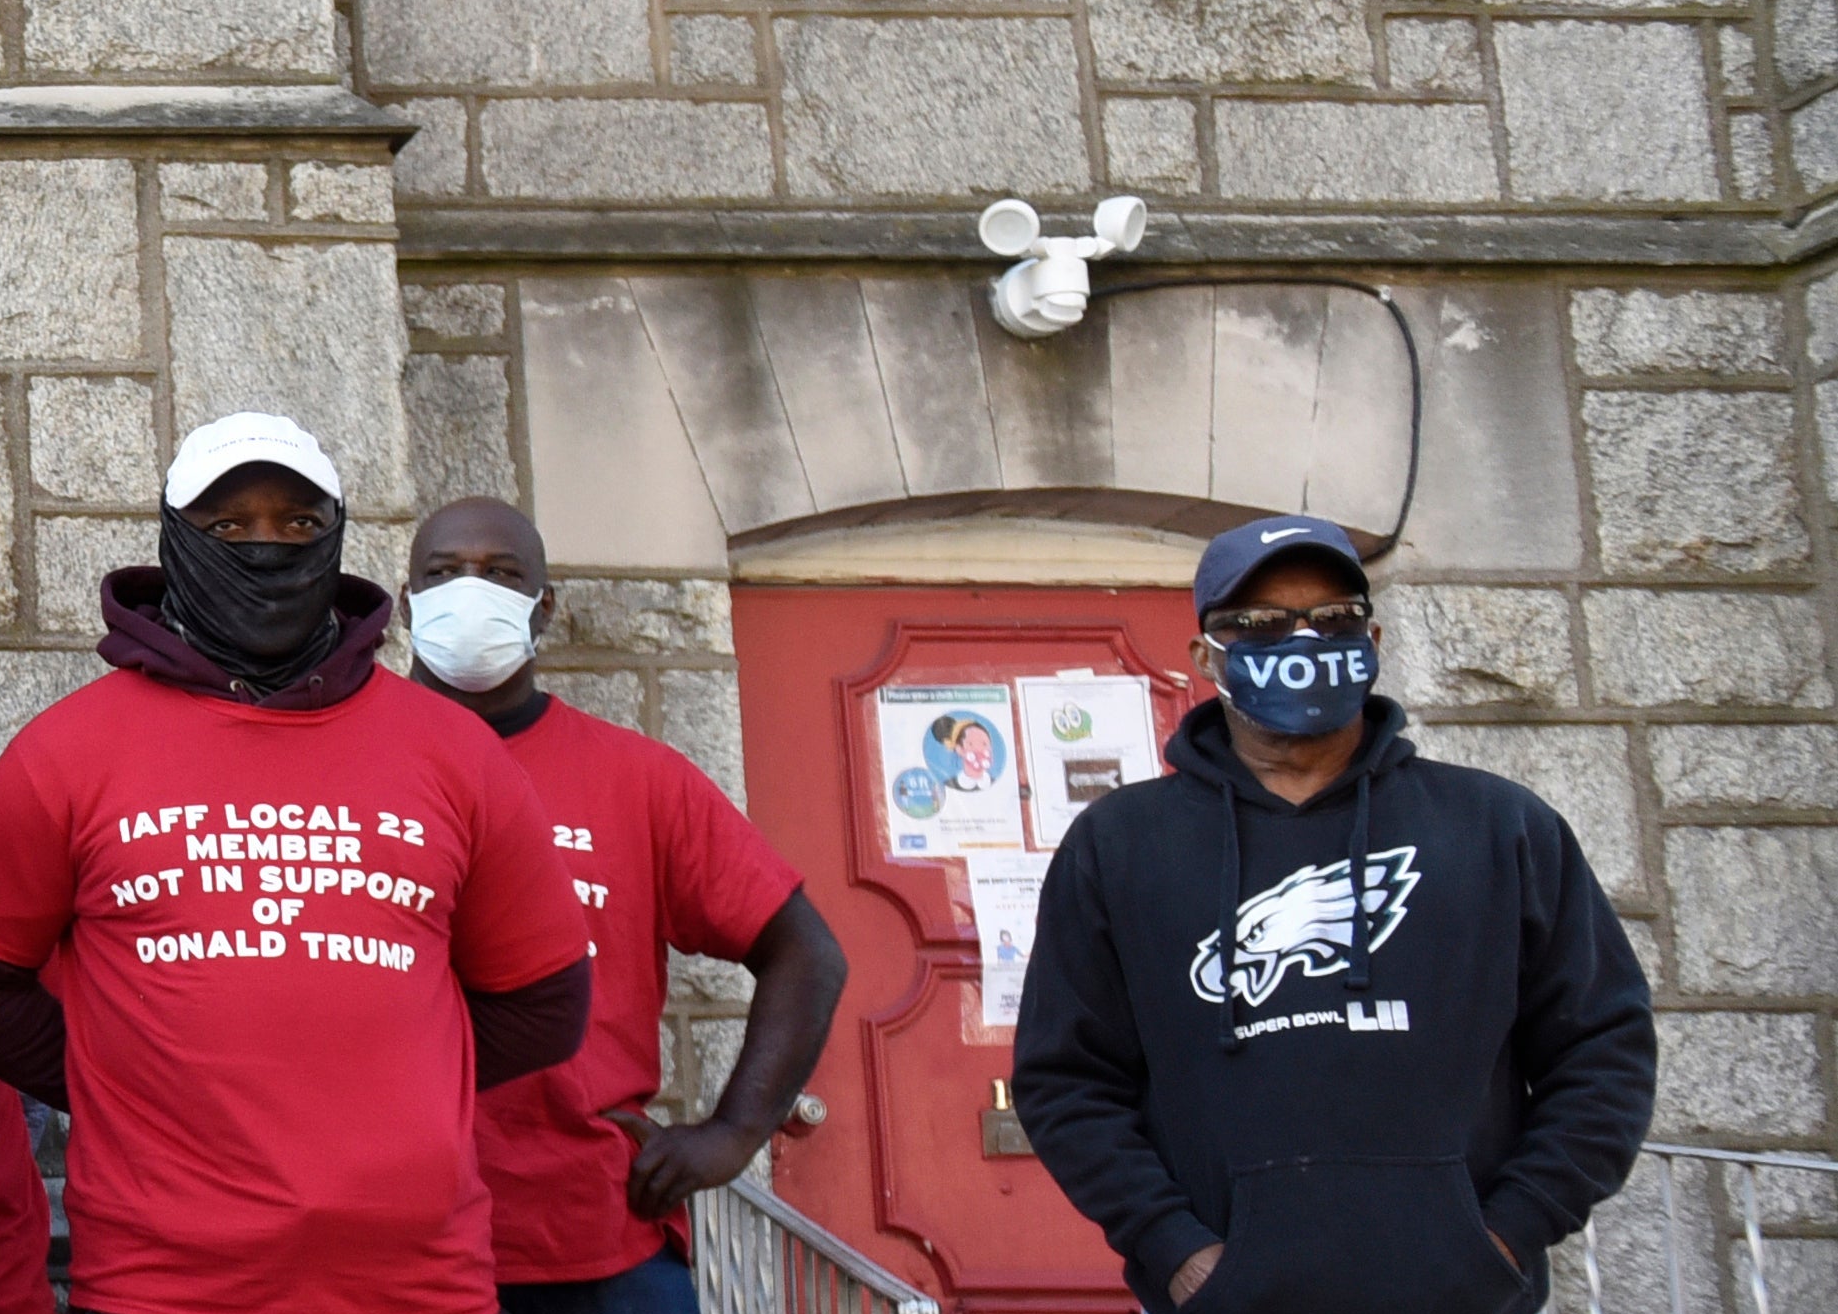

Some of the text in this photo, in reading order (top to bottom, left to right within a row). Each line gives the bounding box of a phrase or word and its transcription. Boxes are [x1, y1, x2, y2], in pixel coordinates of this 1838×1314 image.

[1243, 649, 1368, 690] VOTE
[119, 803, 425, 846] IAFF LOCAL 22
[552, 824, 594, 852] 22
[185, 833, 362, 863] MEMBER
[110, 865, 435, 912] NOT IN SUPPORT
[252, 897, 305, 925] OF
[136, 930, 415, 972] DONALD TRUMP
[1234, 999, 1410, 1040] SUPER BOWL LII
